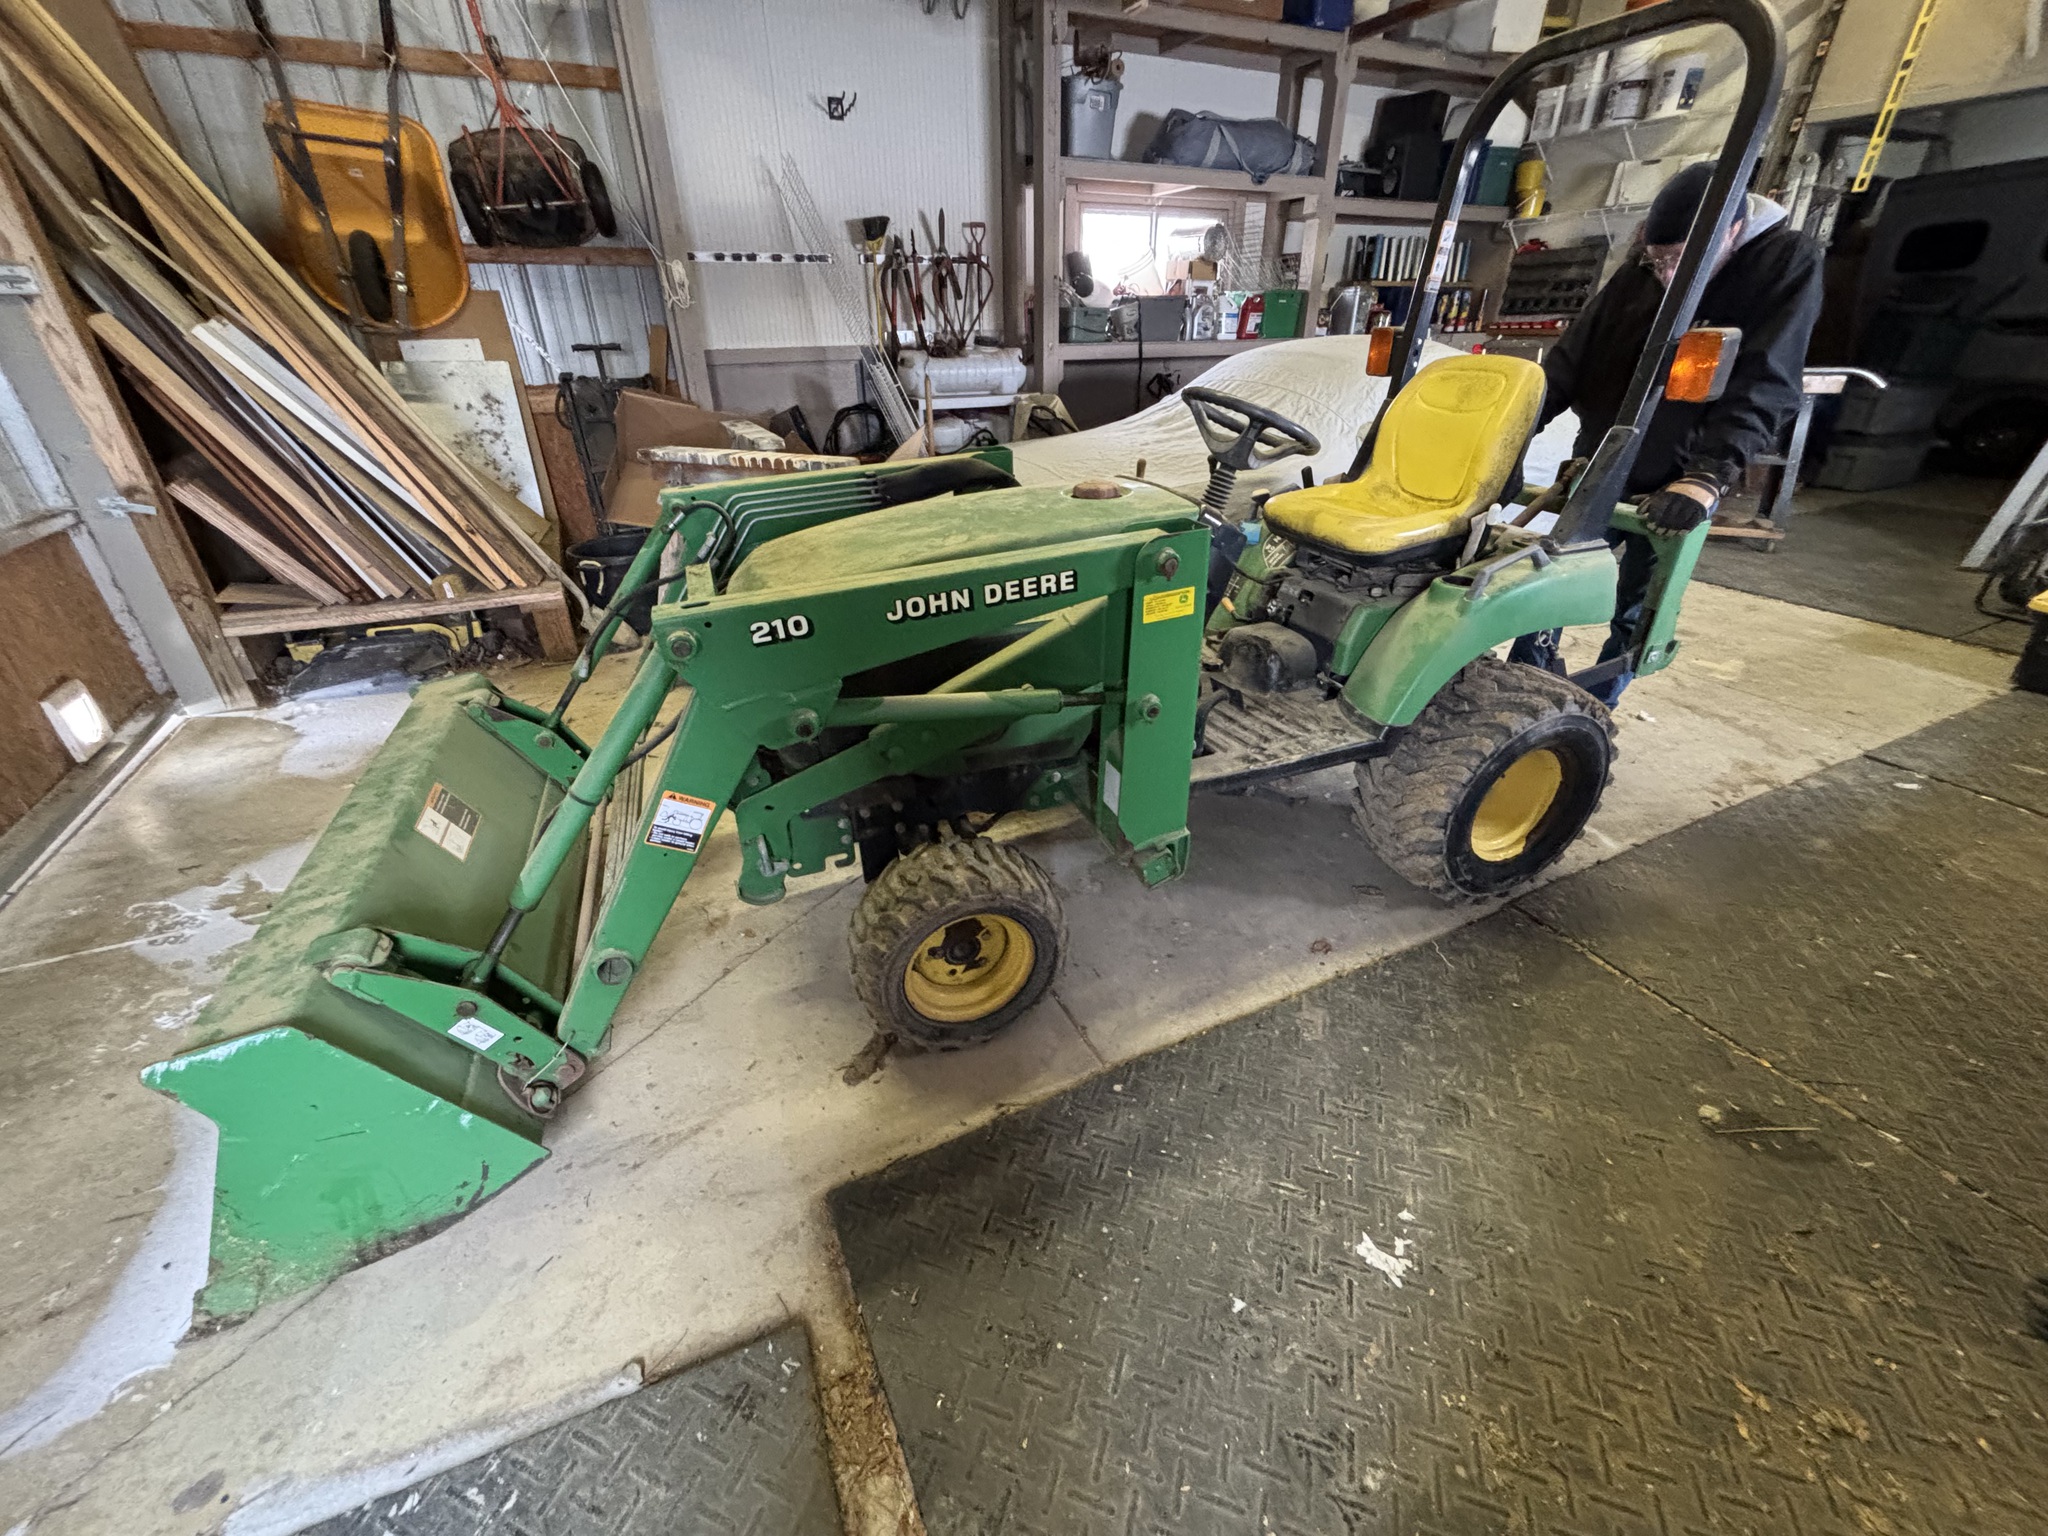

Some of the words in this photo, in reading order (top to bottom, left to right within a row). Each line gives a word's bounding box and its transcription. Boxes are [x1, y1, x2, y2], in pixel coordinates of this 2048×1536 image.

[886, 588, 972, 622] JOHN
[984, 570, 1075, 606] DEERE
[749, 613, 812, 646] 210
[678, 794, 711, 808] WARNING
